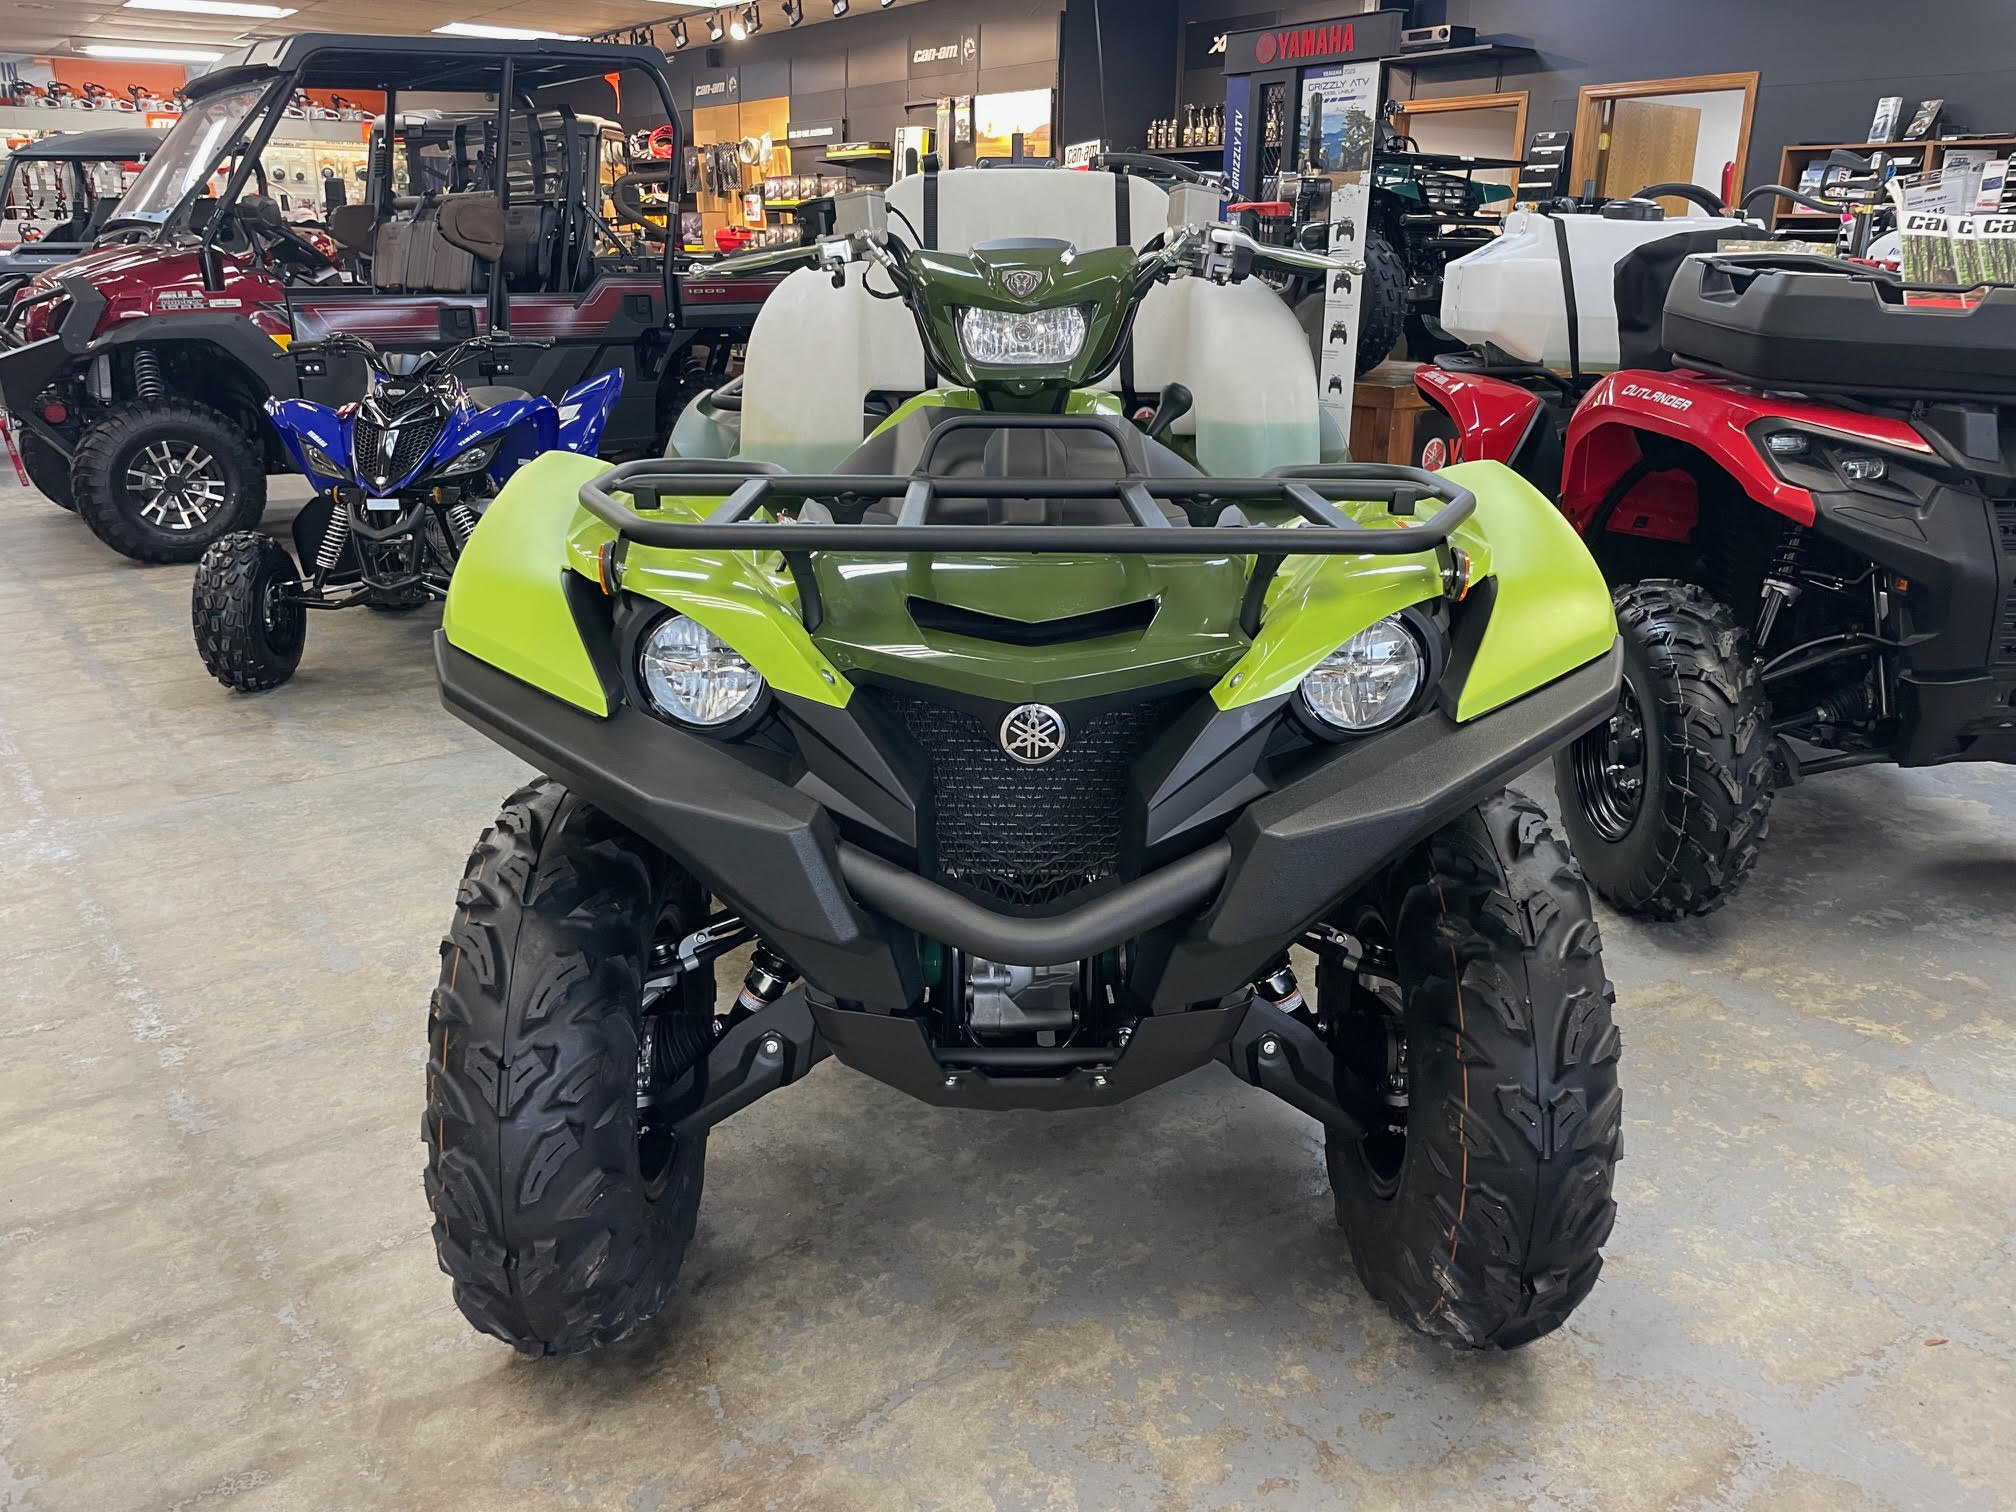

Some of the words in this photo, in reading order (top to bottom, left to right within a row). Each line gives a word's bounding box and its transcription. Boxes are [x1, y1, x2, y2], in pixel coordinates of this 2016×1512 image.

[1278, 23, 1354, 60] YAMAHA
[912, 44, 959, 63] can-am
[695, 81, 725, 97] can-am
[1308, 80, 1347, 92] GRIZZLY
[1350, 78, 1370, 88] ATV
[1234, 109, 1244, 137] ATV
[1067, 144, 1098, 164] can-am
[1231, 136, 1243, 190] GRIZZLY
[1621, 384, 1693, 411] OUTLANDER
